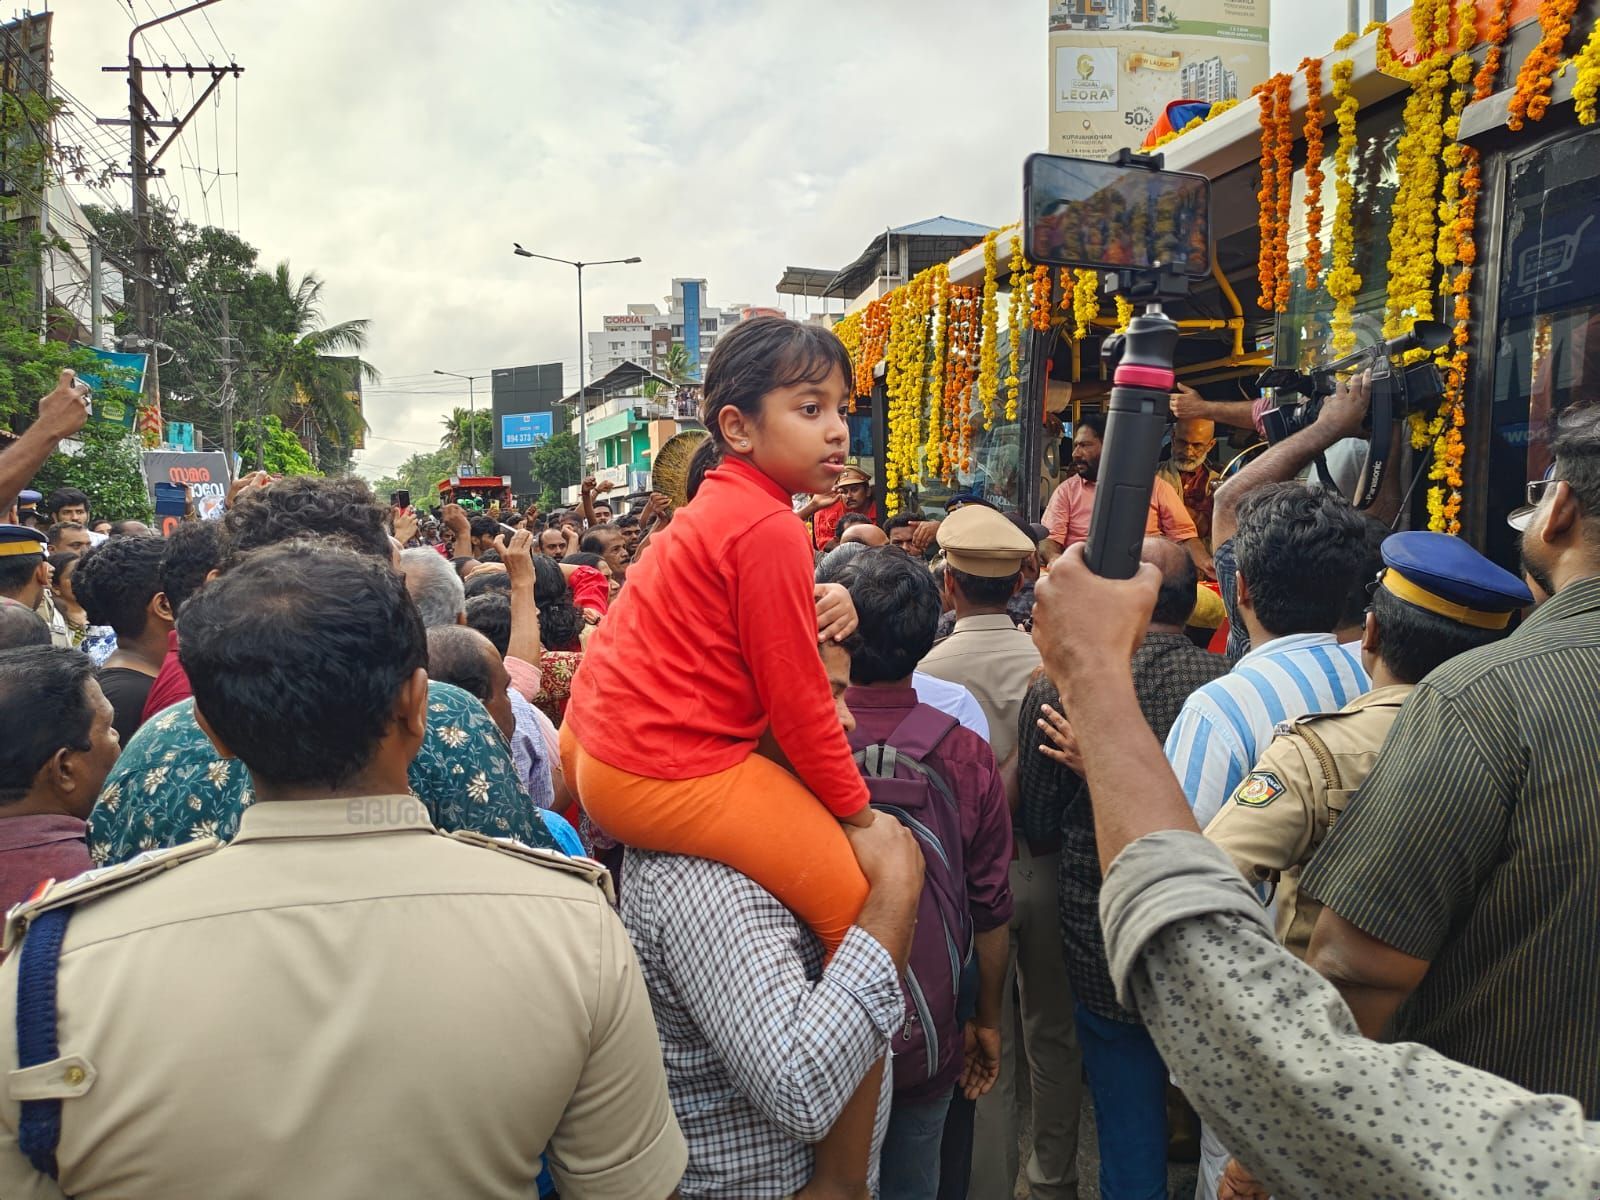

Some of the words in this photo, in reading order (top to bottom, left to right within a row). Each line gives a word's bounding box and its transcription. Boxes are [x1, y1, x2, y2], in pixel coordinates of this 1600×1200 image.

[1061, 89, 1109, 100] LEORA
[1124, 111, 1149, 126] 50+
[605, 315, 645, 324] CORDIAL
[169, 466, 211, 482] സമര
[1365, 460, 1382, 501] Panasonic
